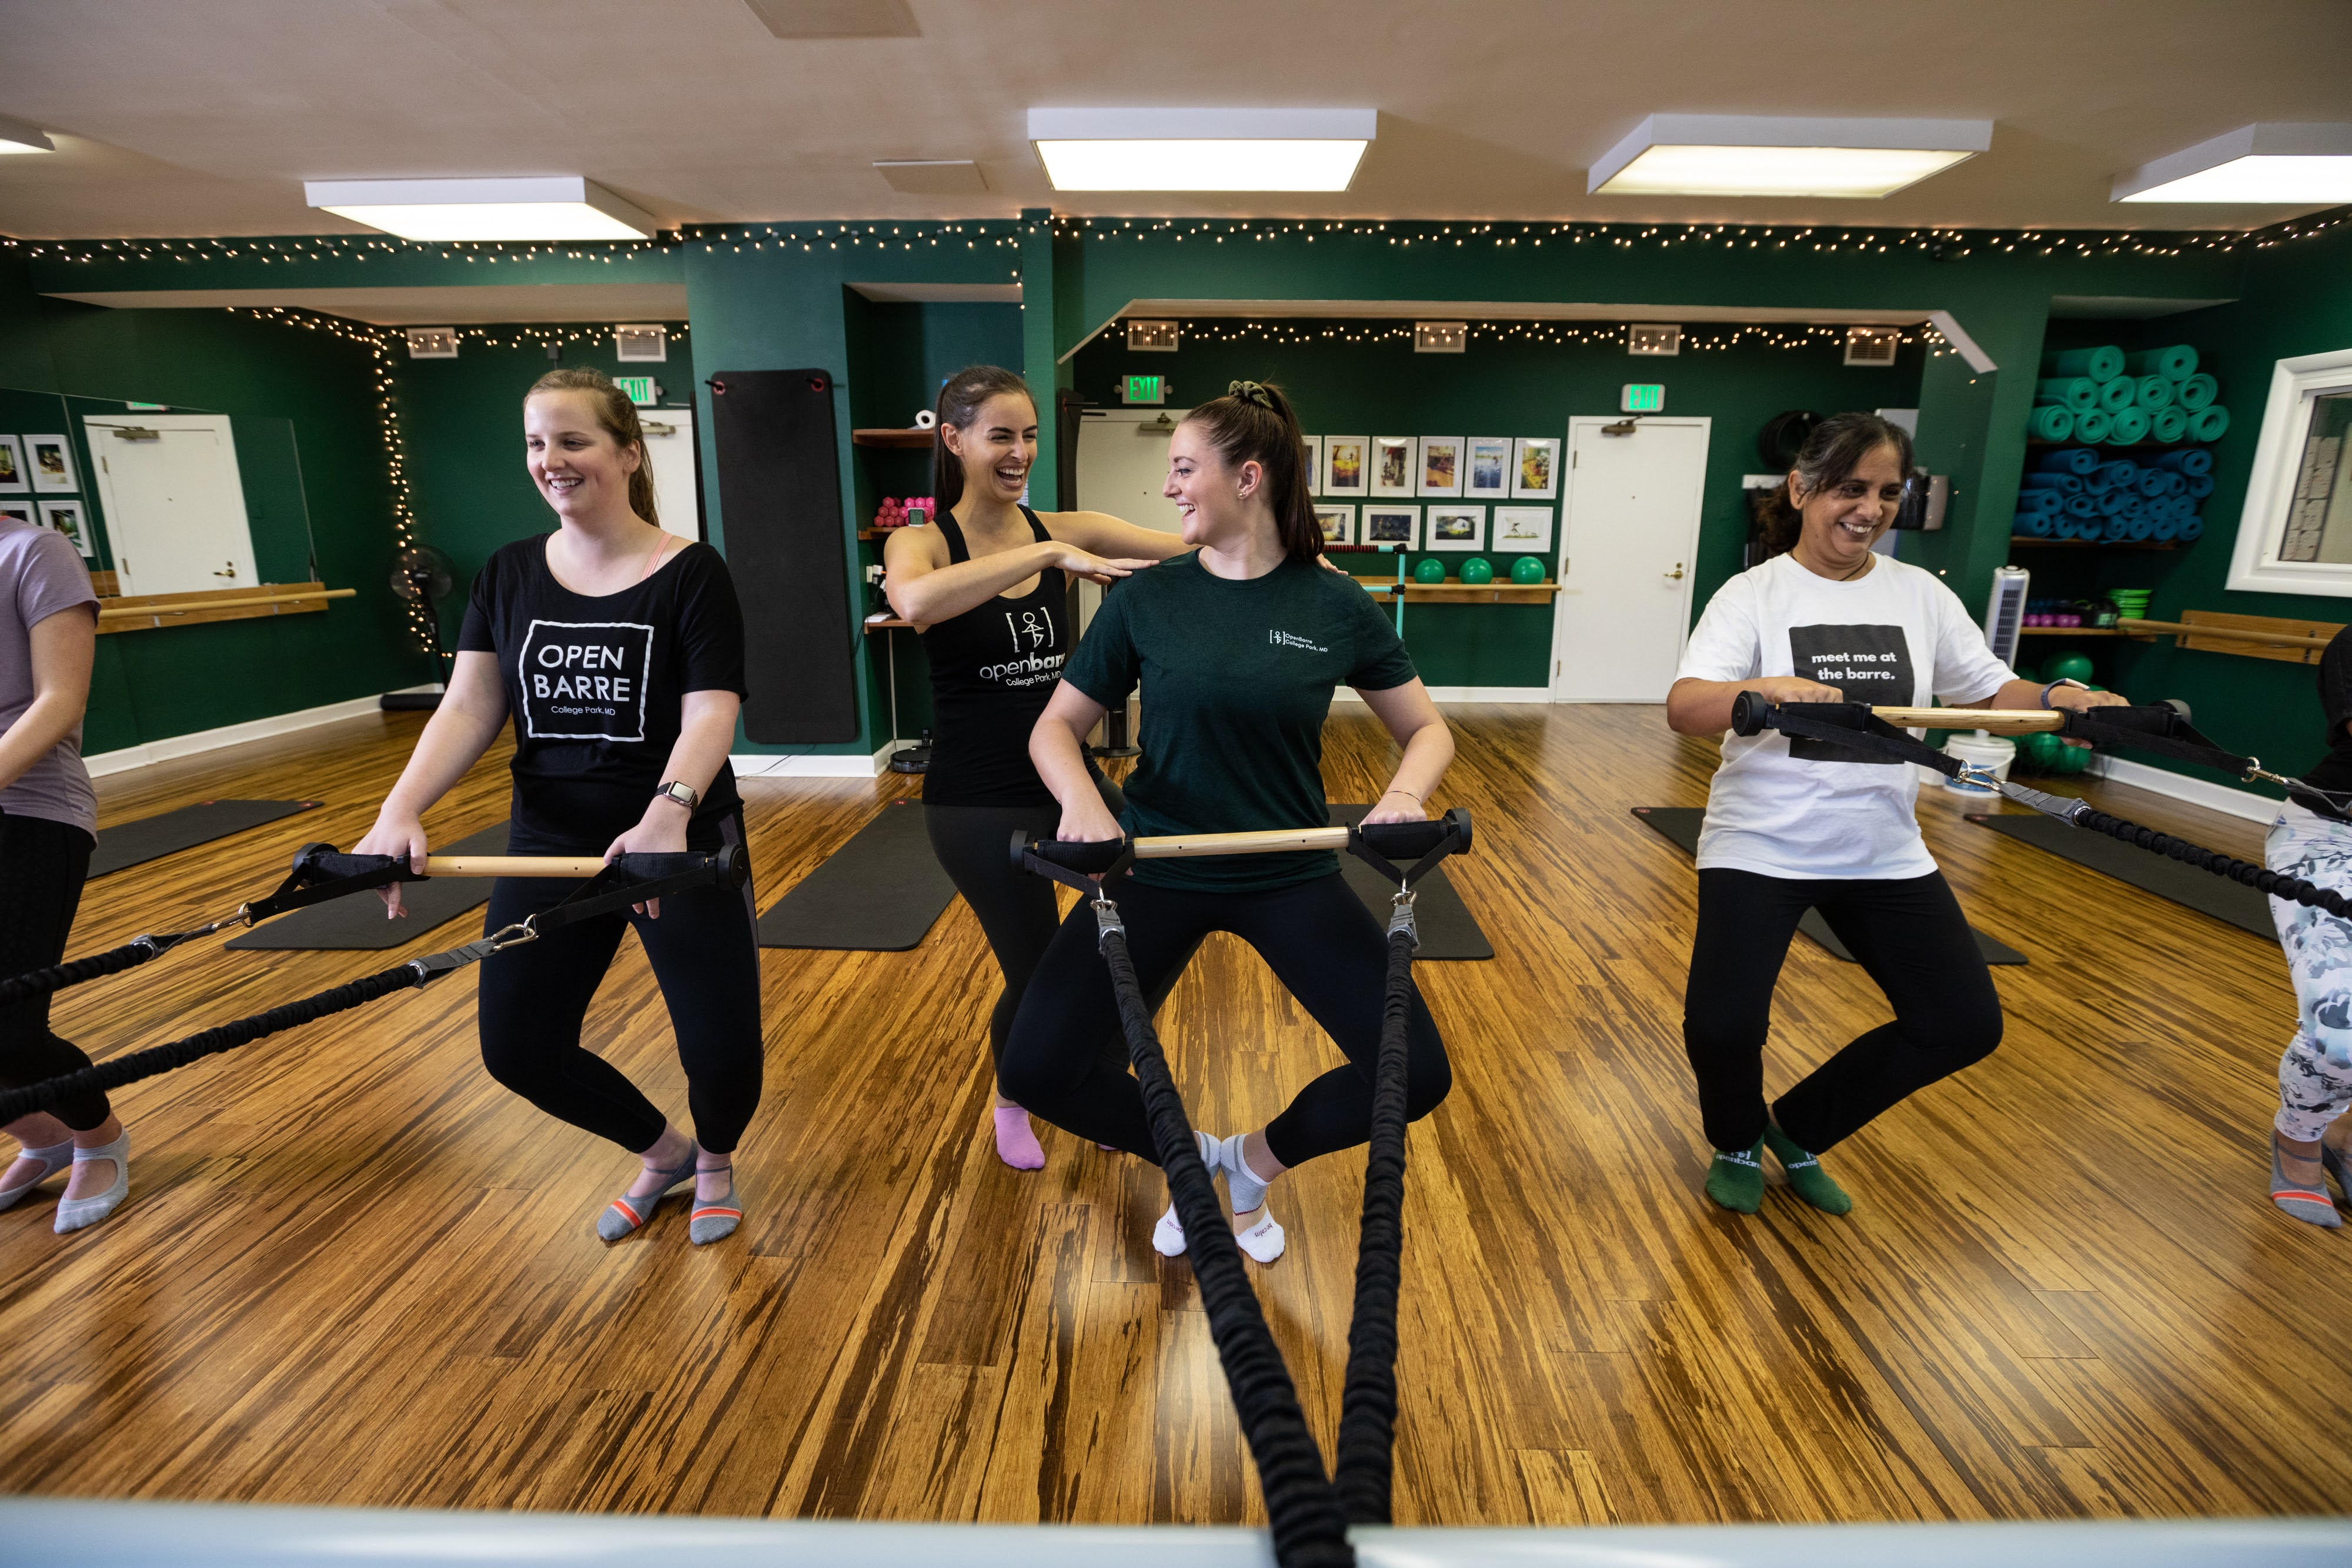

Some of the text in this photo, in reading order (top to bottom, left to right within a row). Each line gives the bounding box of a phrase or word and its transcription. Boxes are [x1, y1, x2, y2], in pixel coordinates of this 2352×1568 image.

[620, 379, 648, 401] EXIT
[1130, 377, 1159, 400] EXIT
[1629, 385, 1661, 410] EXIT
[1285, 633, 1312, 644] OpenBarre
[1285, 639, 1304, 648] College
[538, 644, 624, 670] OPEN
[1812, 652, 1897, 663] meet me at
[1006, 671, 1061, 687] College Park, MD
[1818, 667, 1896, 680] the barre.
[533, 674, 630, 701] BARRE
[551, 706, 583, 715] College
[604, 707, 616, 716] MD
